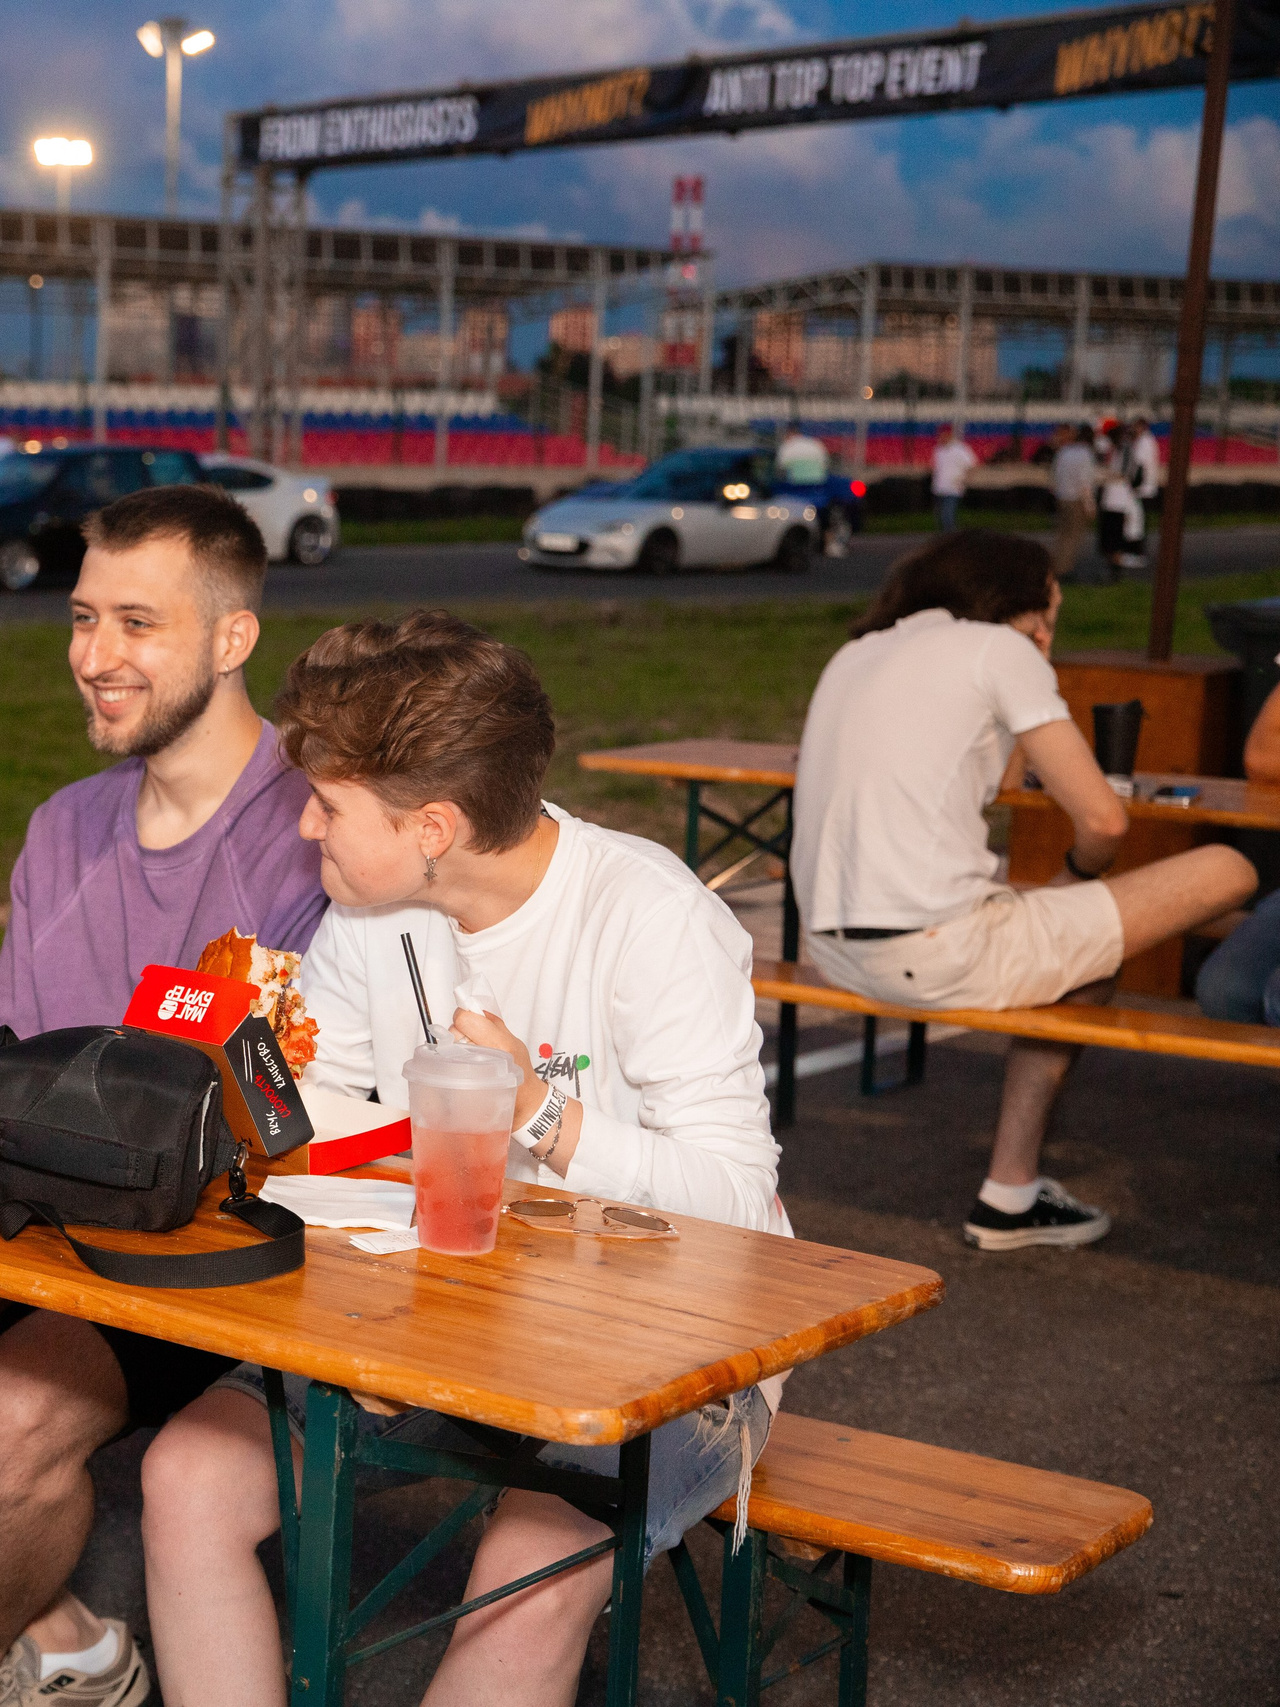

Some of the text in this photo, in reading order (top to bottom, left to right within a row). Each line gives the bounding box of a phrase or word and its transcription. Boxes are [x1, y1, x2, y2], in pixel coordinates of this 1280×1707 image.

[774, 58, 828, 110] TOP
[830, 52, 884, 104] TOP
[885, 42, 987, 98] EVENT
[259, 95, 479, 161] FROM ENTHUSIASTS
[165, 985, 215, 1008] БУРГЕР
[175, 1004, 207, 1023] МАГ
[257, 1037, 286, 1089] КАЧЕСТВО.
[265, 1106, 281, 1136] ВКУС.
